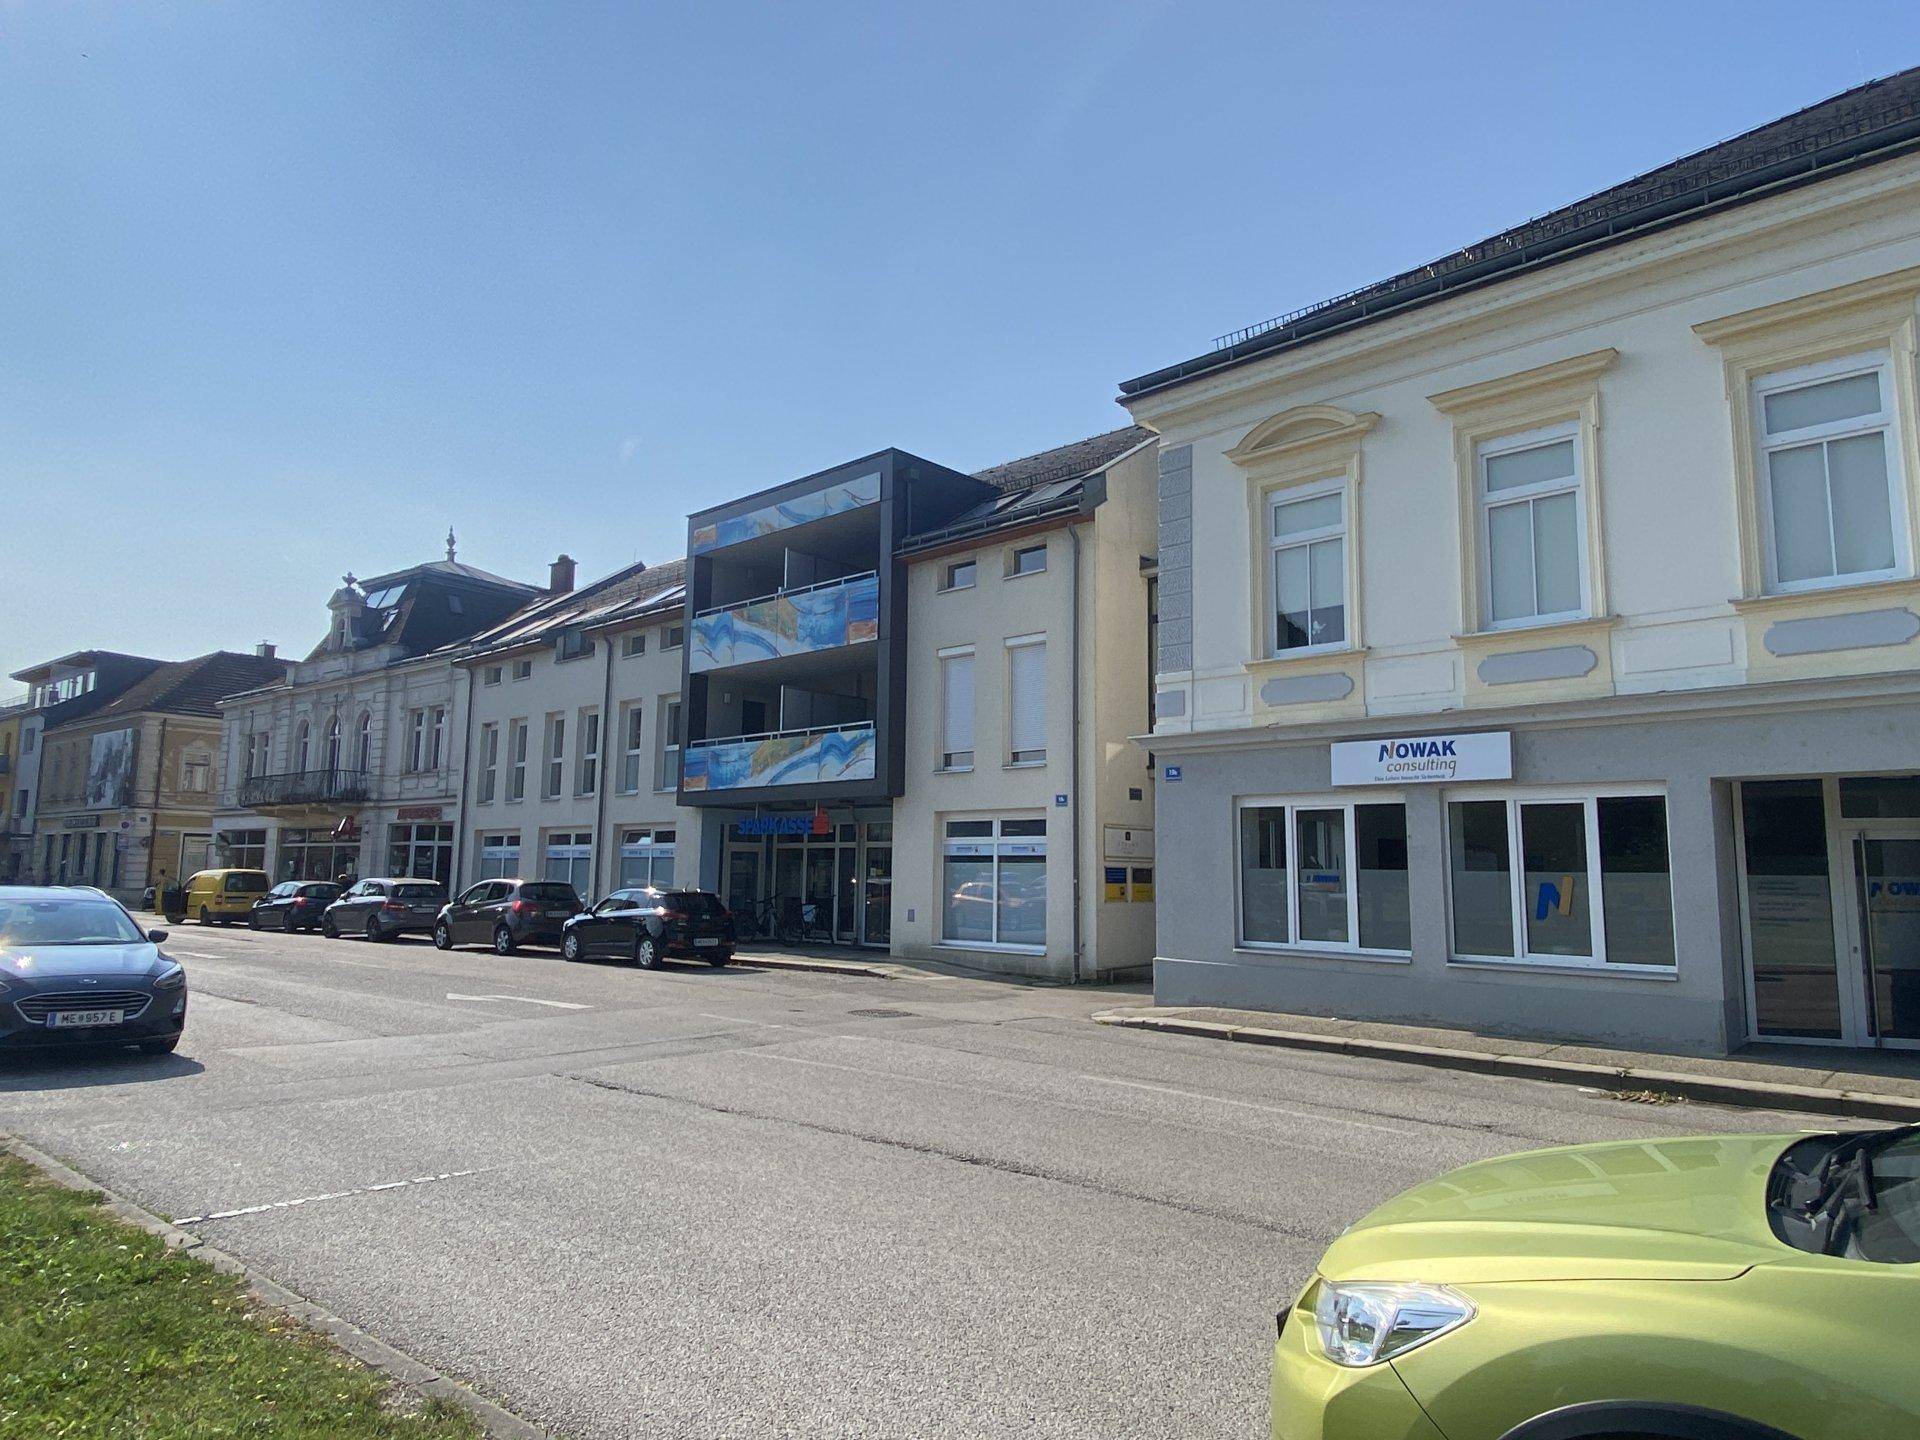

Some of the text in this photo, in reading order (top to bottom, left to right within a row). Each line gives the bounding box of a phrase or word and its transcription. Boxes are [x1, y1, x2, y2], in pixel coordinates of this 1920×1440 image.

[1378, 739, 1457, 763] NOWAK
[1386, 757, 1457, 778] consulting
[85, 1012, 107, 1023] 957
